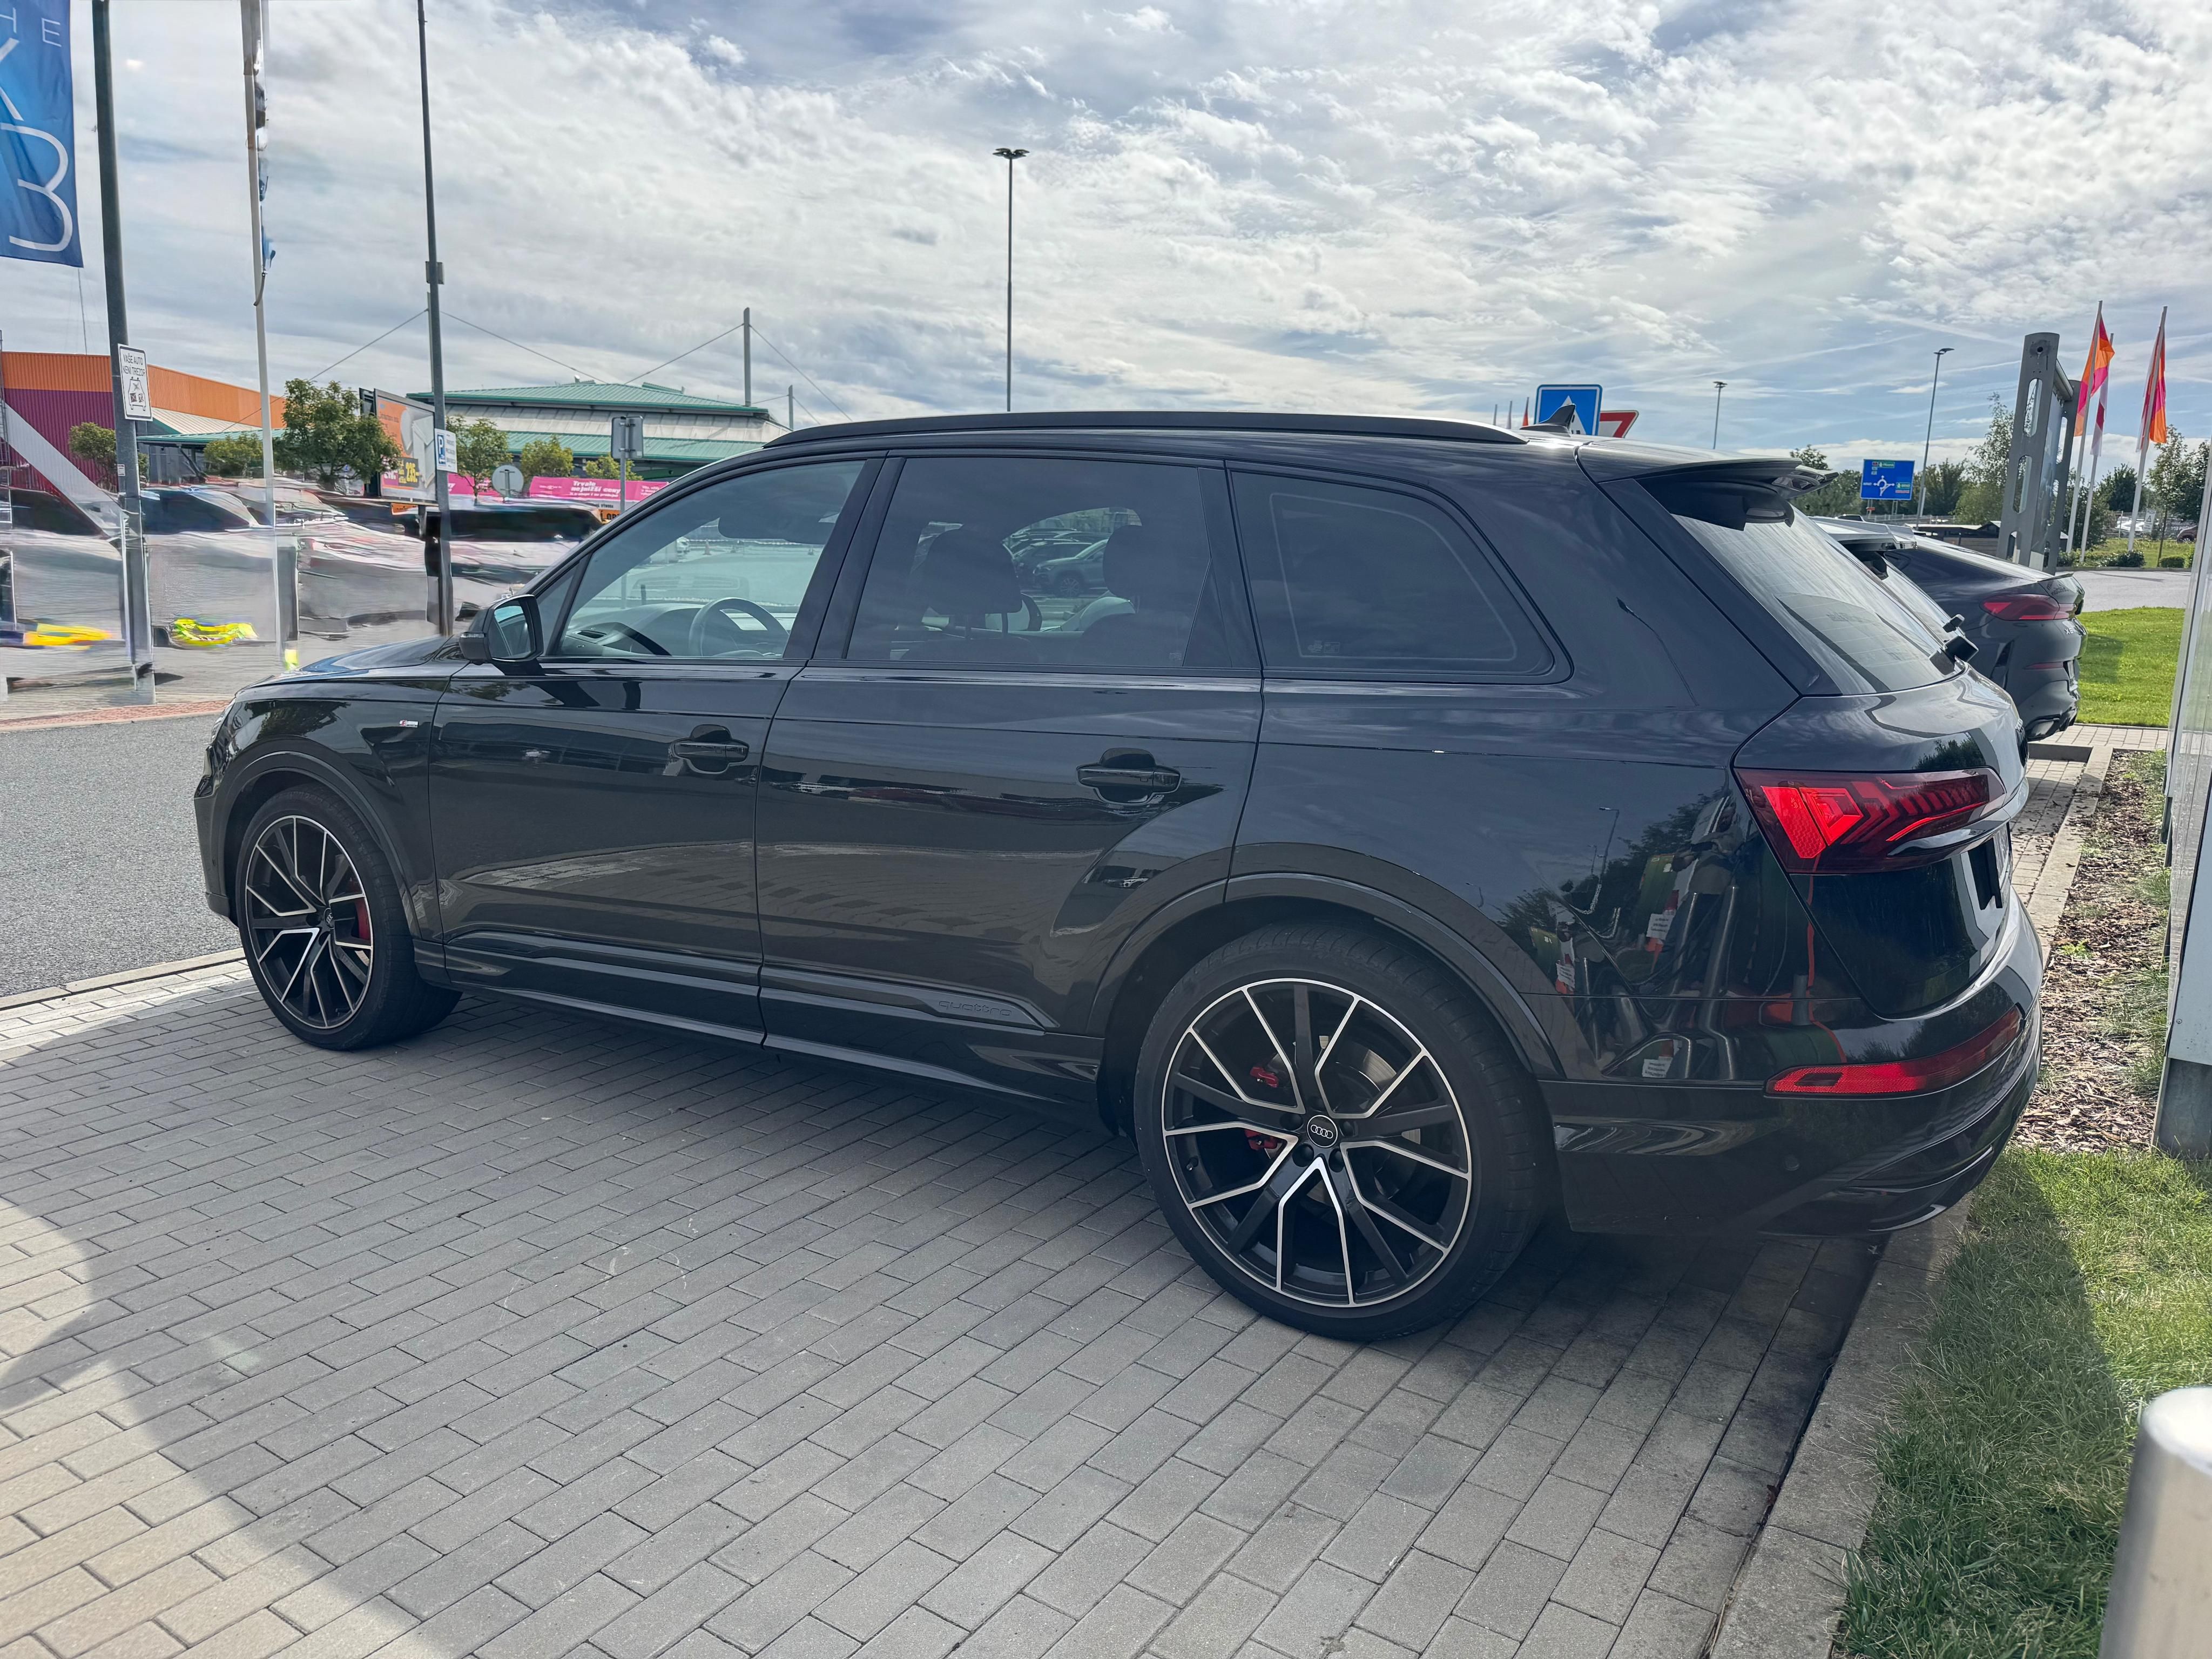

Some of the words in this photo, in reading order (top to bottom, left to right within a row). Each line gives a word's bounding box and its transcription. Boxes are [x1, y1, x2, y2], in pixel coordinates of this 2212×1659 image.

[123, 354, 133, 364] VAŠE
[133, 356, 143, 366] AUTO
[939, 1001, 1012, 1016] quattro
